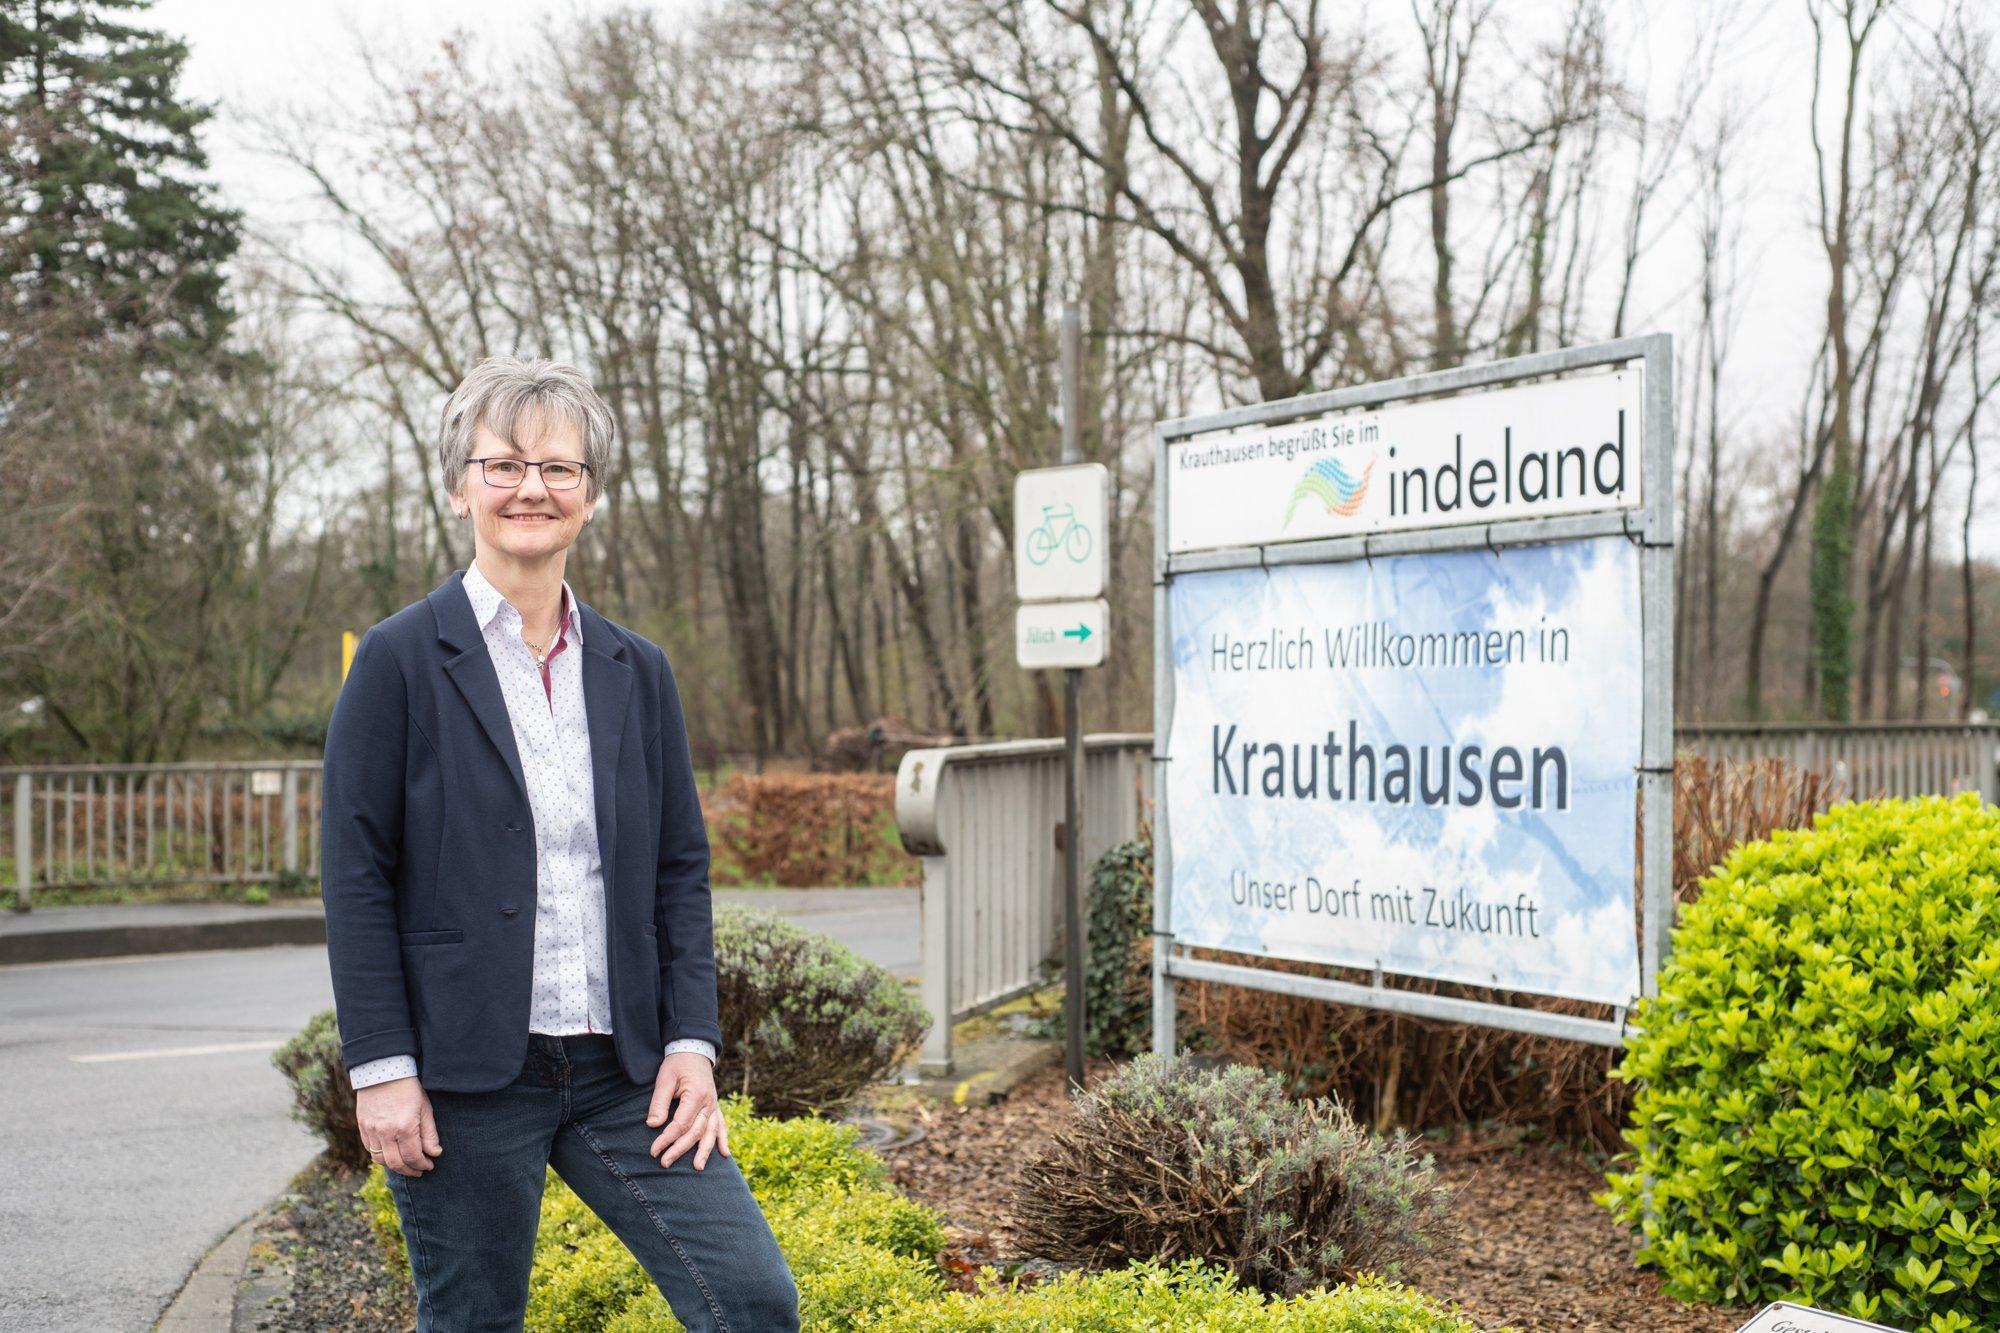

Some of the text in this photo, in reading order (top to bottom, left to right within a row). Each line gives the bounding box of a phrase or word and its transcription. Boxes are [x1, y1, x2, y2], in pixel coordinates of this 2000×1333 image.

[1180, 420, 1379, 470] Krauthausen begrüßt Sie im
[1389, 409, 1625, 516] indeland
[1211, 616, 1568, 672] Herzlich Willkommen in
[1212, 720, 1567, 810] Krauthausen
[1230, 868, 1540, 938] Unser Dorf mit Zukunft
